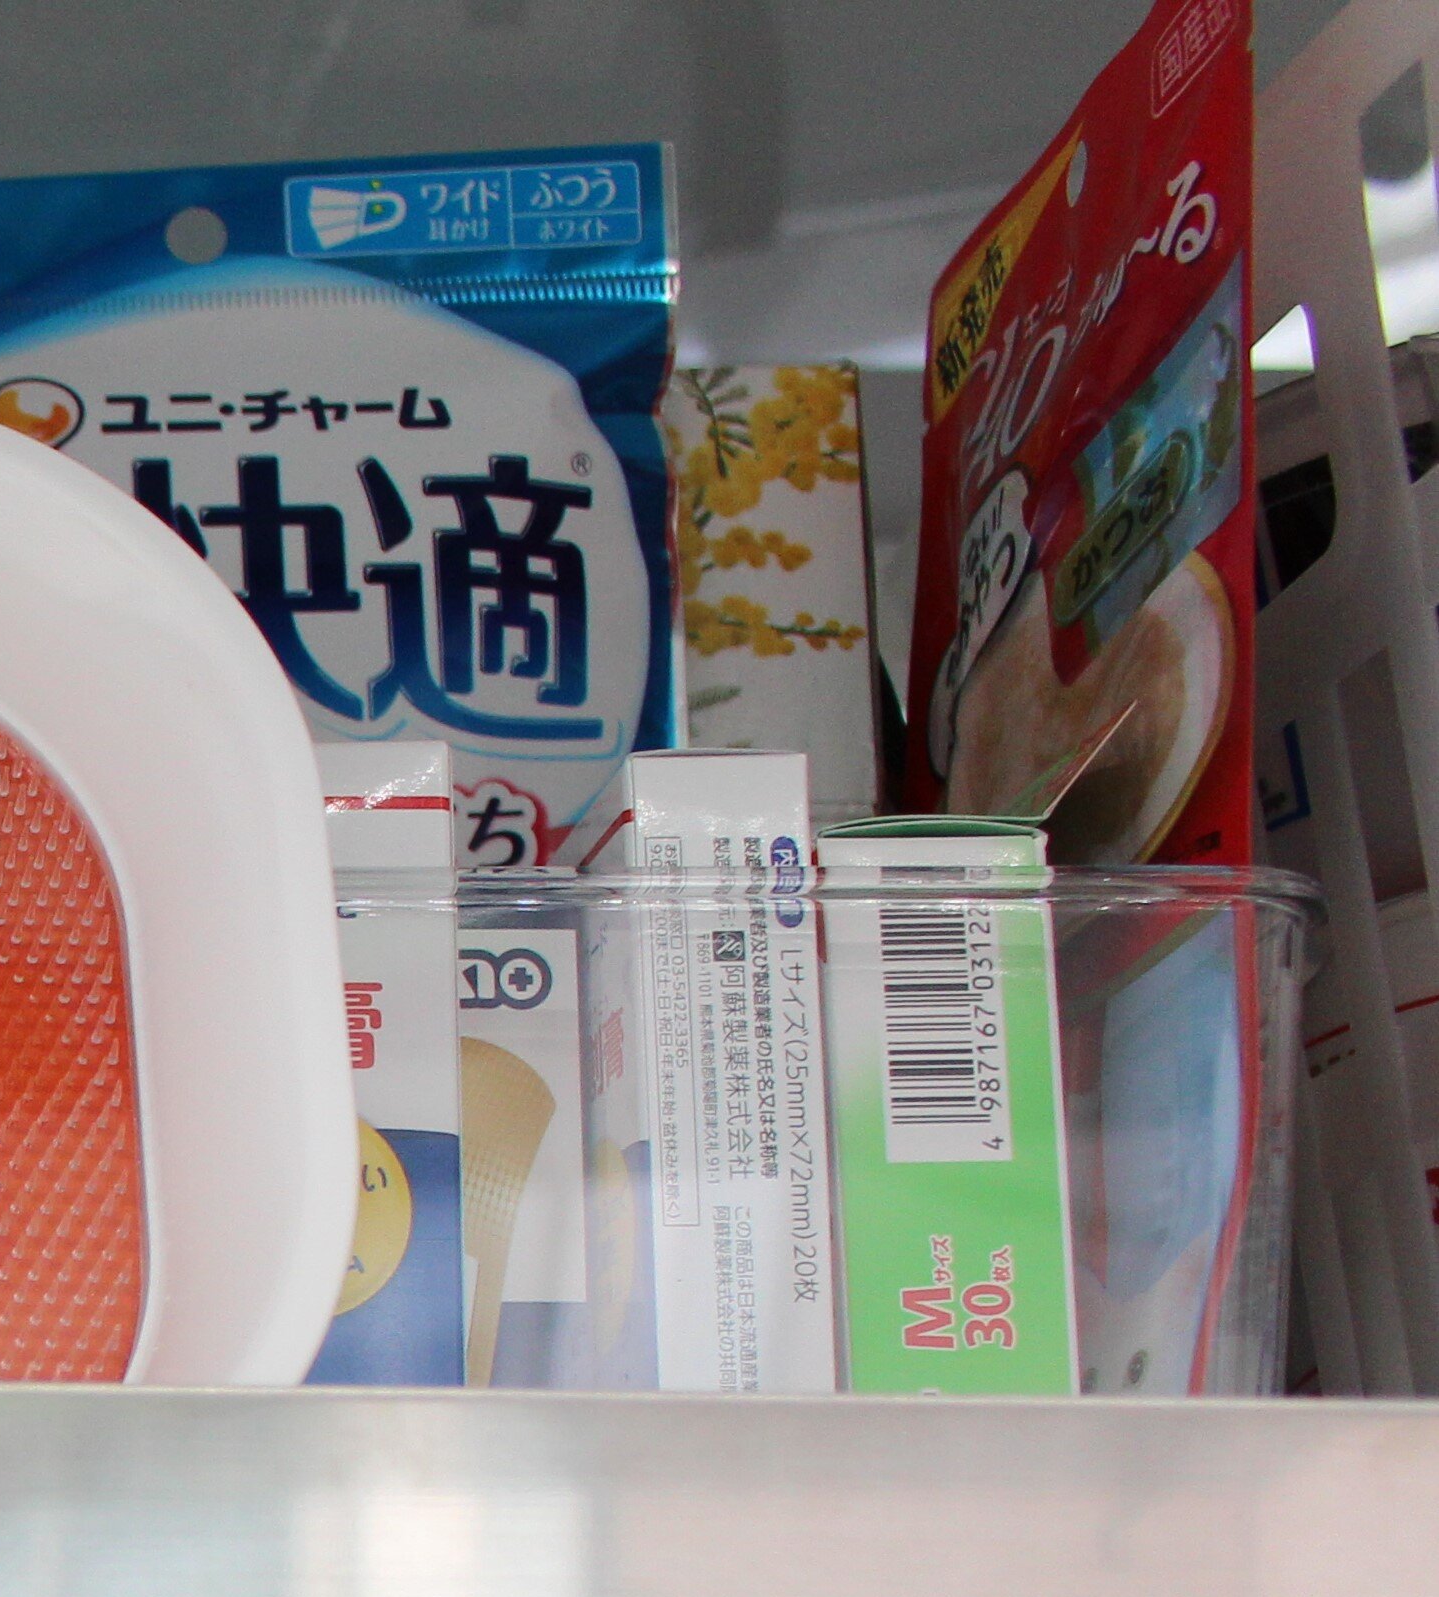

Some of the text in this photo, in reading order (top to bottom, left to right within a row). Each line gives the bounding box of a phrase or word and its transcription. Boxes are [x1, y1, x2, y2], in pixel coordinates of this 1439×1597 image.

[420, 179, 502, 215] ワイド
[429, 218, 490, 243] 耳かけ
[529, 168, 618, 210] ふつう
[538, 218, 610, 243] ホワイト
[934, 236, 1007, 398] 新発売
[98, 386, 453, 434] ユニ・チャーム
[1071, 466, 1173, 600] かつお
[670, 955, 690, 1069] 03-5422-3365
[743, 836, 779, 1181] 製造業者及び製造業者の氏名又は名称等
[968, 904, 1005, 1151] 4 987167 03122
[721, 964, 756, 1181] 阿蘇製薬株式会社
[900, 1233, 957, 1352] M サイズ
[960, 1245, 1016, 1350] 30 枚入
